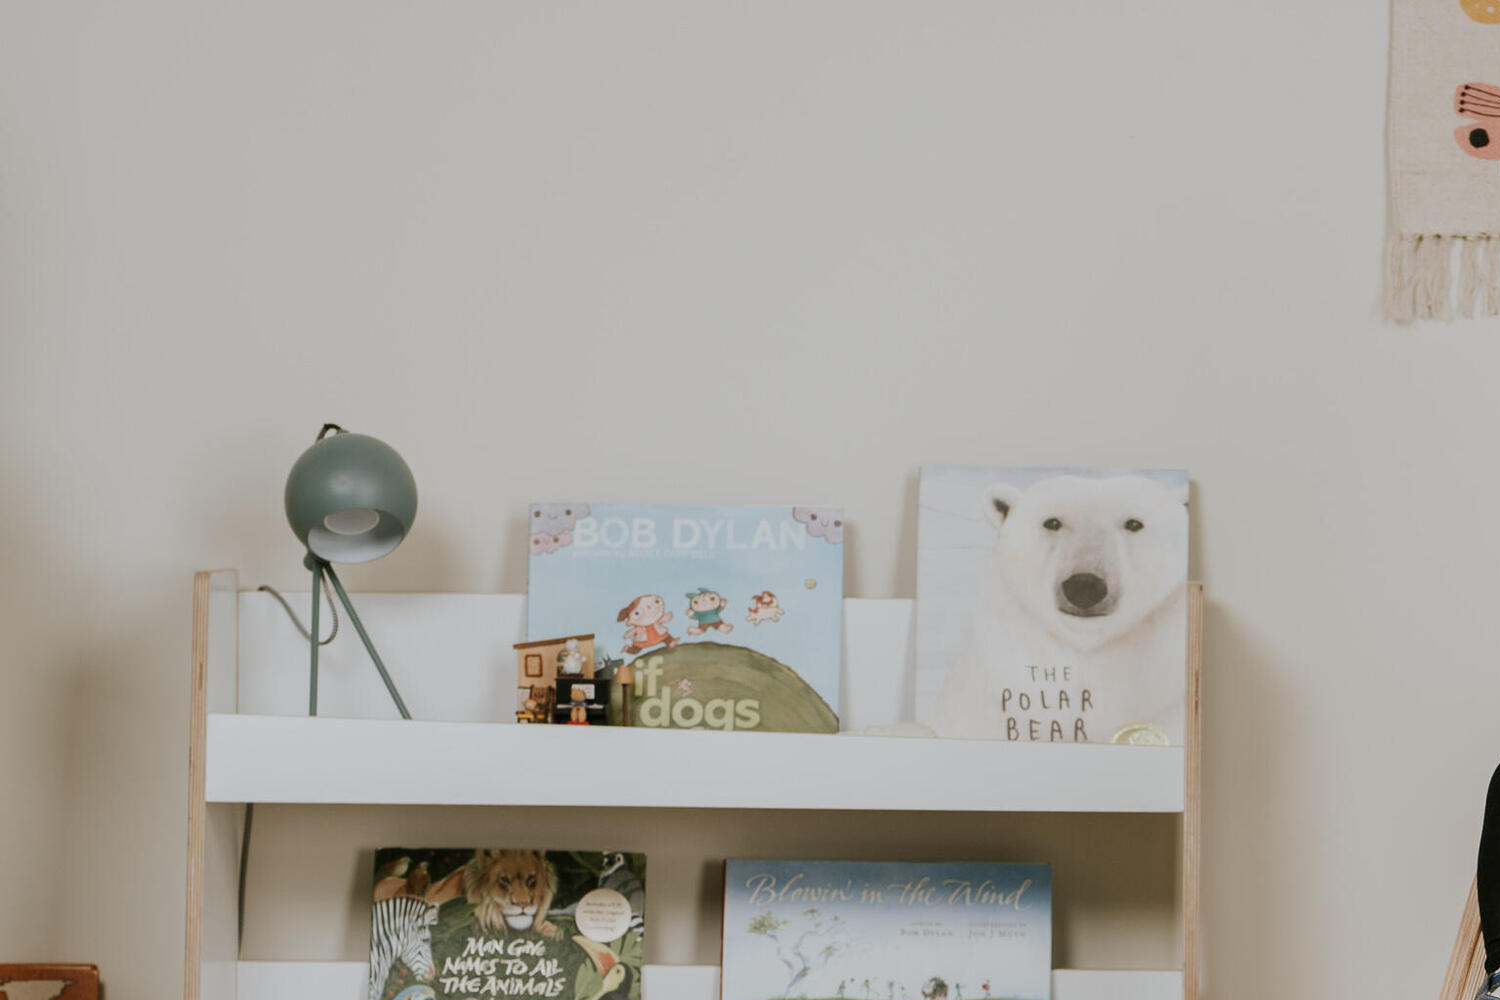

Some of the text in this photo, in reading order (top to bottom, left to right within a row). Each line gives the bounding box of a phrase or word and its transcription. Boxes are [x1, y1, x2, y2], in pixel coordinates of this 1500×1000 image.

[573, 517, 807, 550] BOB DYLAN
[634, 655, 664, 697] if
[1026, 666, 1071, 682] THE
[640, 686, 761, 731] dogs
[1002, 688, 1093, 712] POLAR
[1007, 717, 1088, 742] BEAR
[746, 872, 1032, 911] Blowin' in the Wind
[500, 958, 528, 975] TO
[528, 958, 564, 977] ALL
[439, 976, 481, 994] THE
